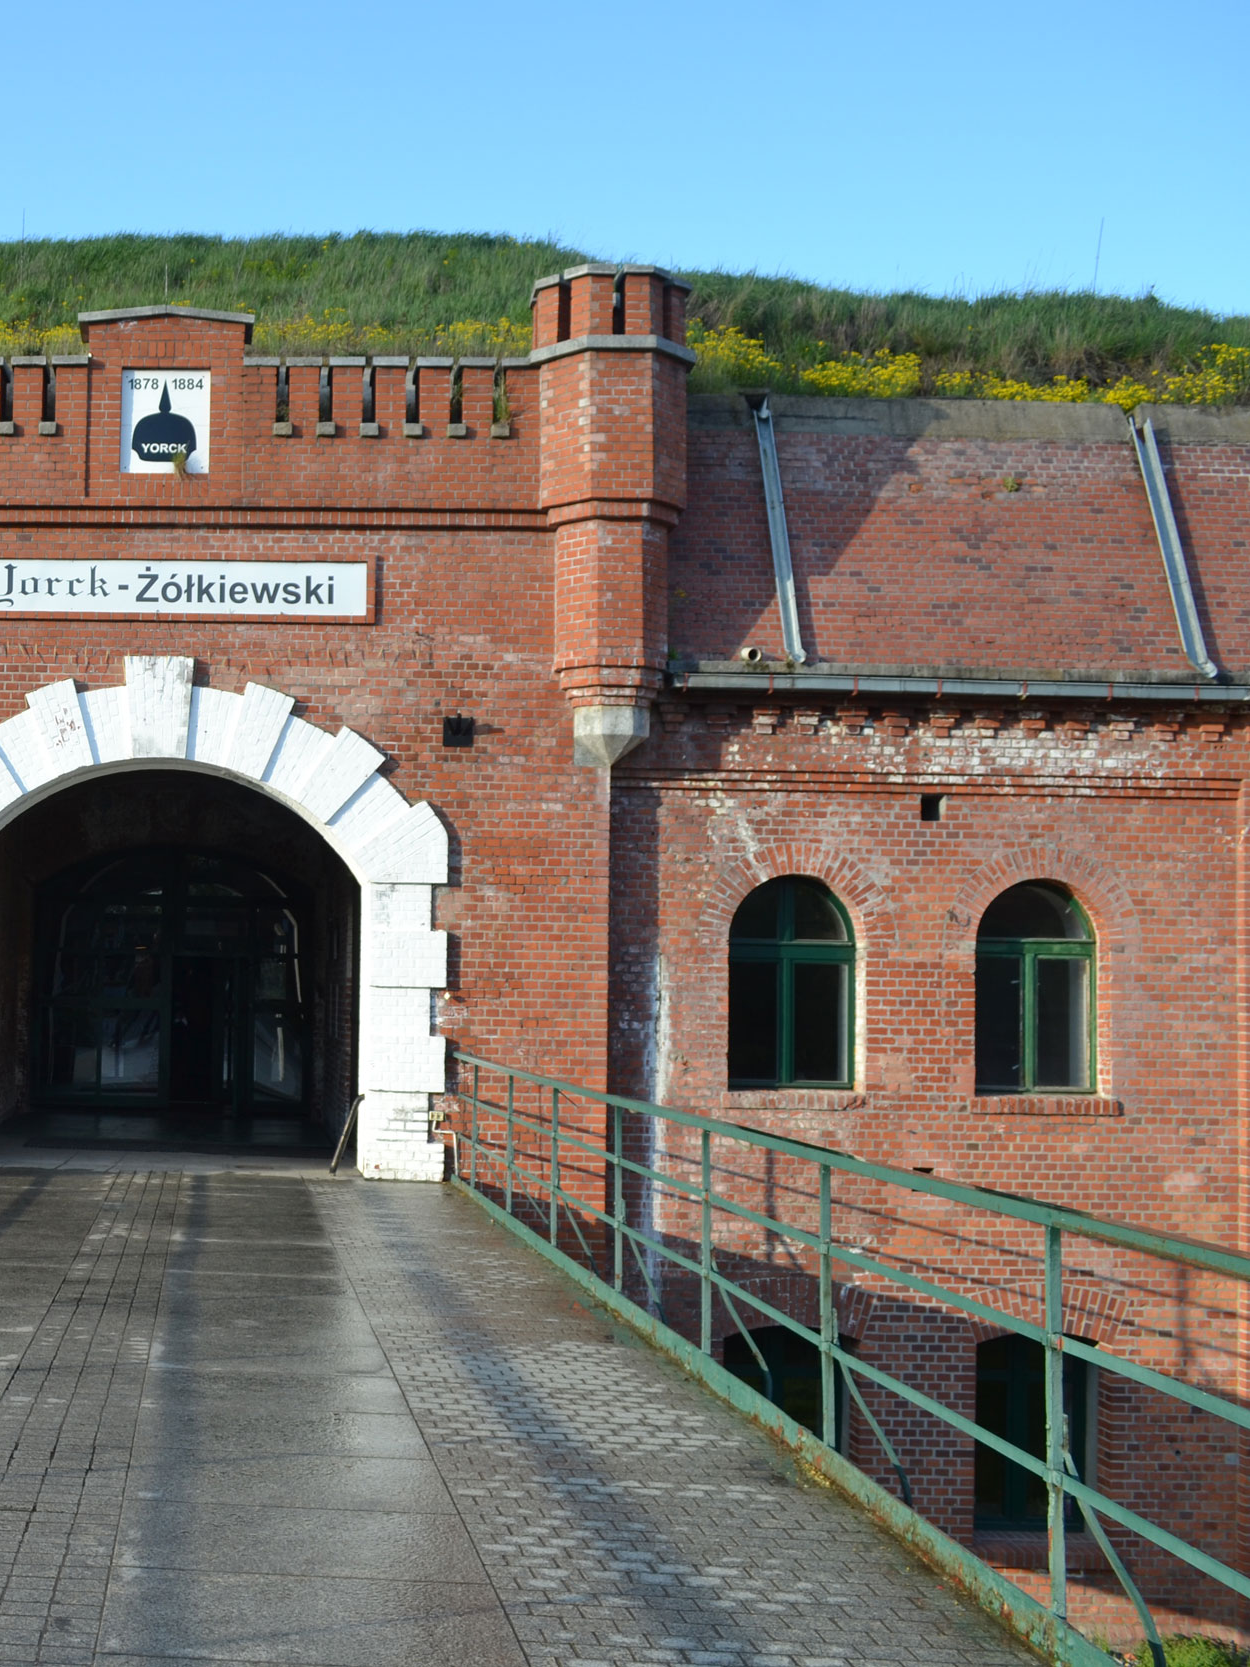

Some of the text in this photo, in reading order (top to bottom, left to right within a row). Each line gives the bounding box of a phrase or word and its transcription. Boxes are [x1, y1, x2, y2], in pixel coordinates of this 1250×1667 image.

[128, 378, 204, 390] 1878 1884
[141, 442, 187, 454] YORCK
